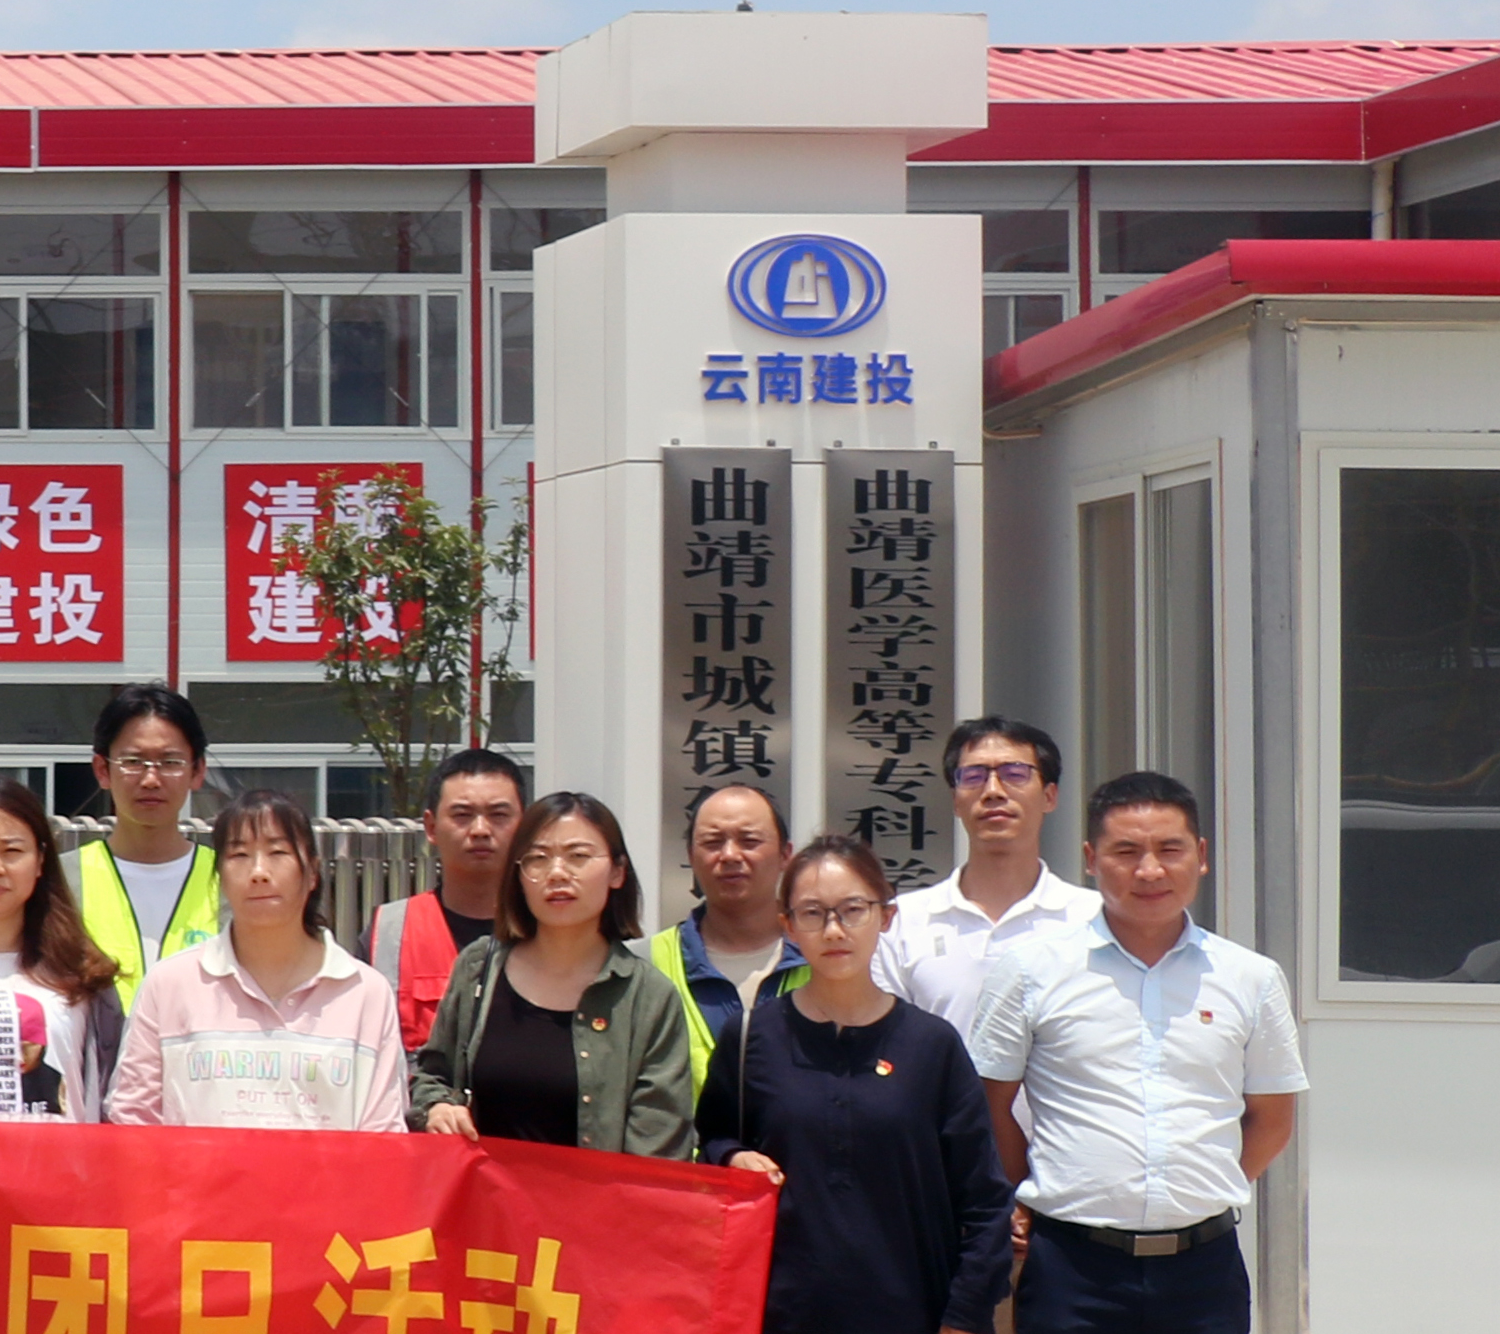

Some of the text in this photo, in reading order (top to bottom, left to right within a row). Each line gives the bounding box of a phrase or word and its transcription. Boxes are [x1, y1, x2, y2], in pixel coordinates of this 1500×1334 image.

[702, 352, 913, 404] 云南建投
[681, 467, 776, 899] 曲靖市城镇
[186, 1050, 281, 1082] WARM
[290, 1052, 322, 1082] IT
